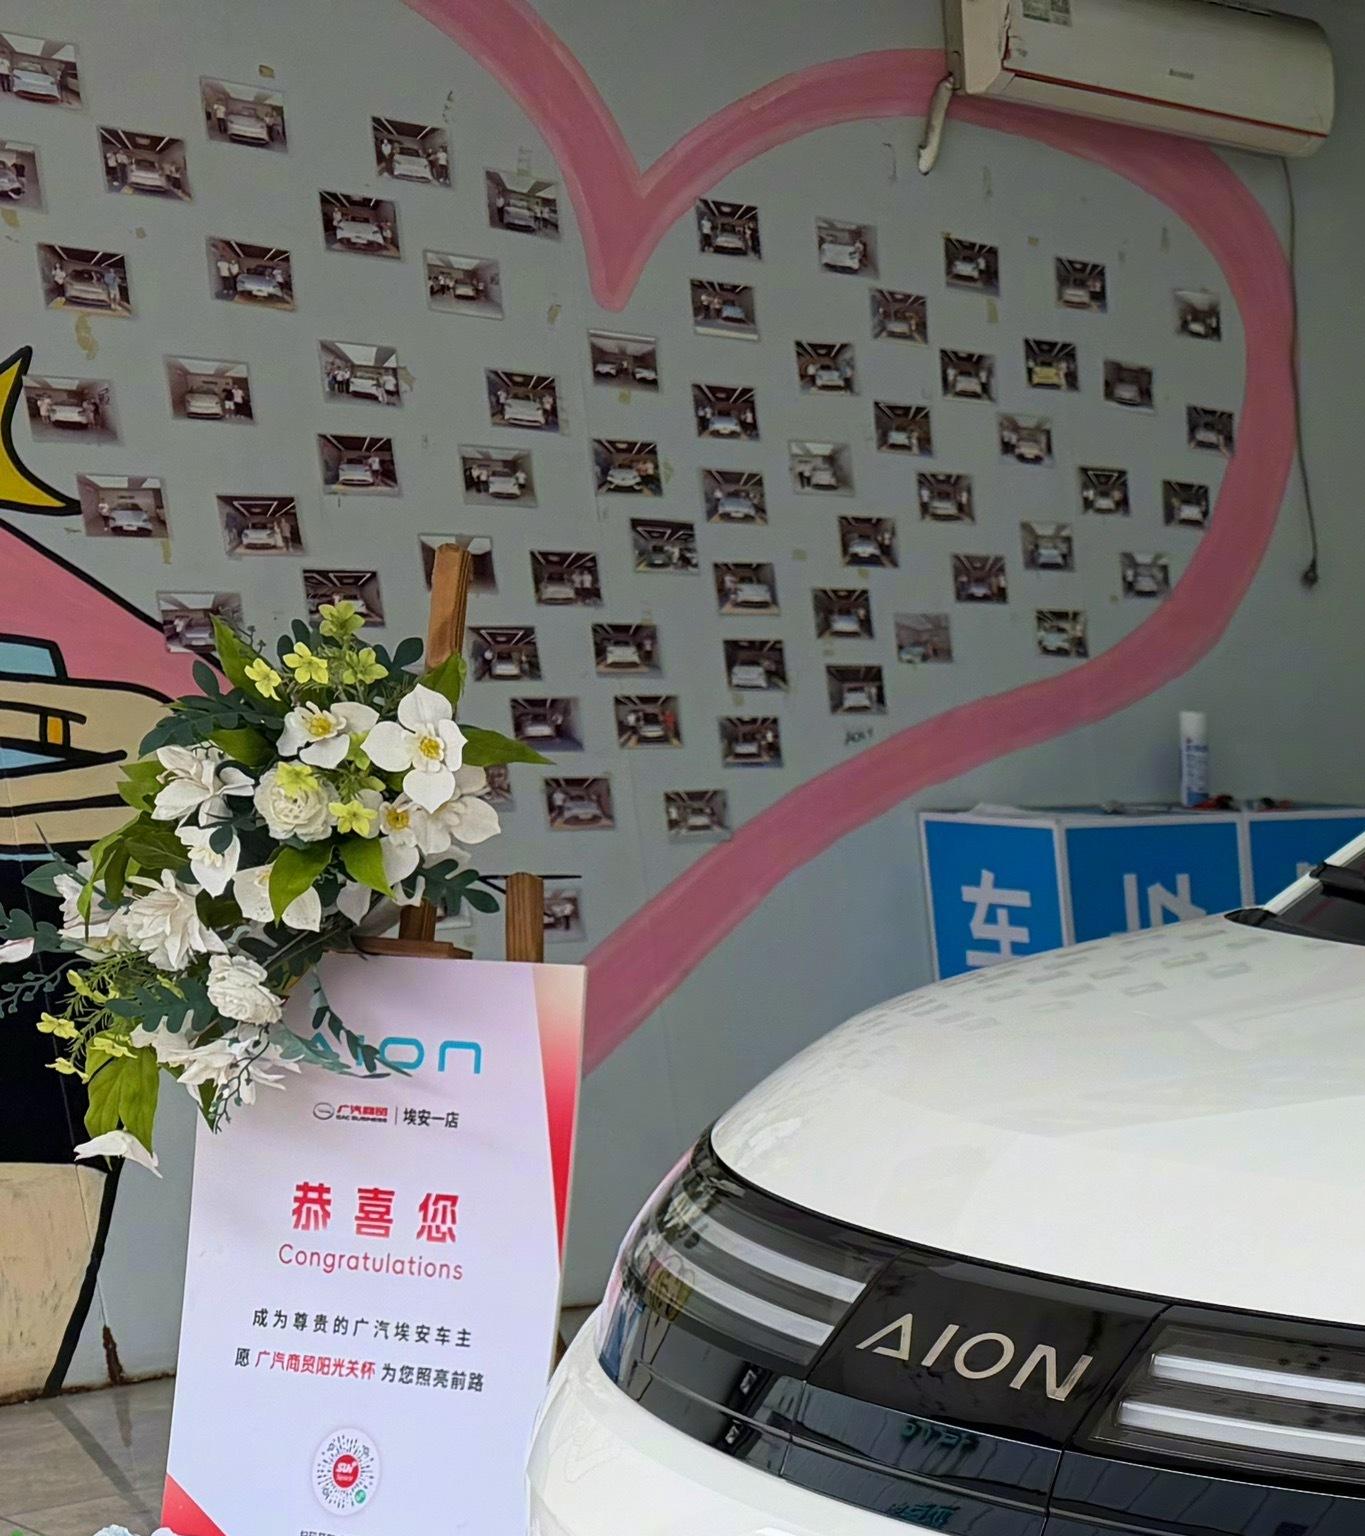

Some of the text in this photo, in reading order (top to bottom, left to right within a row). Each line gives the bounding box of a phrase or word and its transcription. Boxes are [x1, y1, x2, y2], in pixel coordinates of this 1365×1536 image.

[402, 1107, 460, 1129] 埃安一店
[291, 1181, 460, 1244] 恭喜您
[278, 1243, 464, 1281] Congratulations
[252, 1307, 472, 1348] 成为尊贵的广汽埃安车主
[855, 1313, 1094, 1401] AION
[381, 1363, 485, 1392] 为您照亮前路
